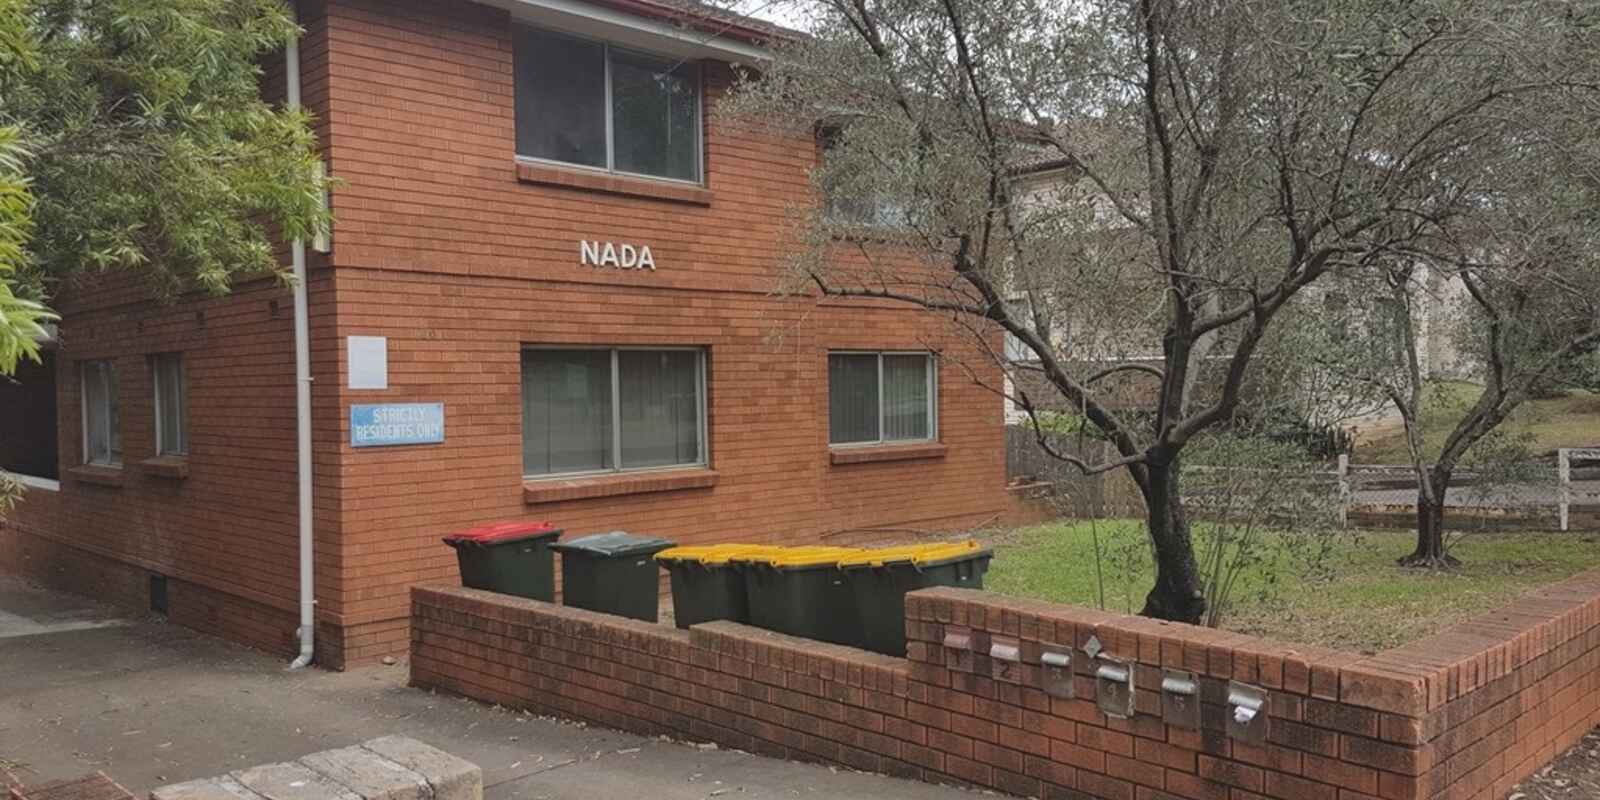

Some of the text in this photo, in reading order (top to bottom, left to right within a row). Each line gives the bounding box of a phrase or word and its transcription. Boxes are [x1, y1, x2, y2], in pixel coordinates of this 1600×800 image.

[580, 240, 656, 270] NADA
[373, 407, 427, 423] STRICTLY
[356, 424, 414, 440] RESIDENTS
